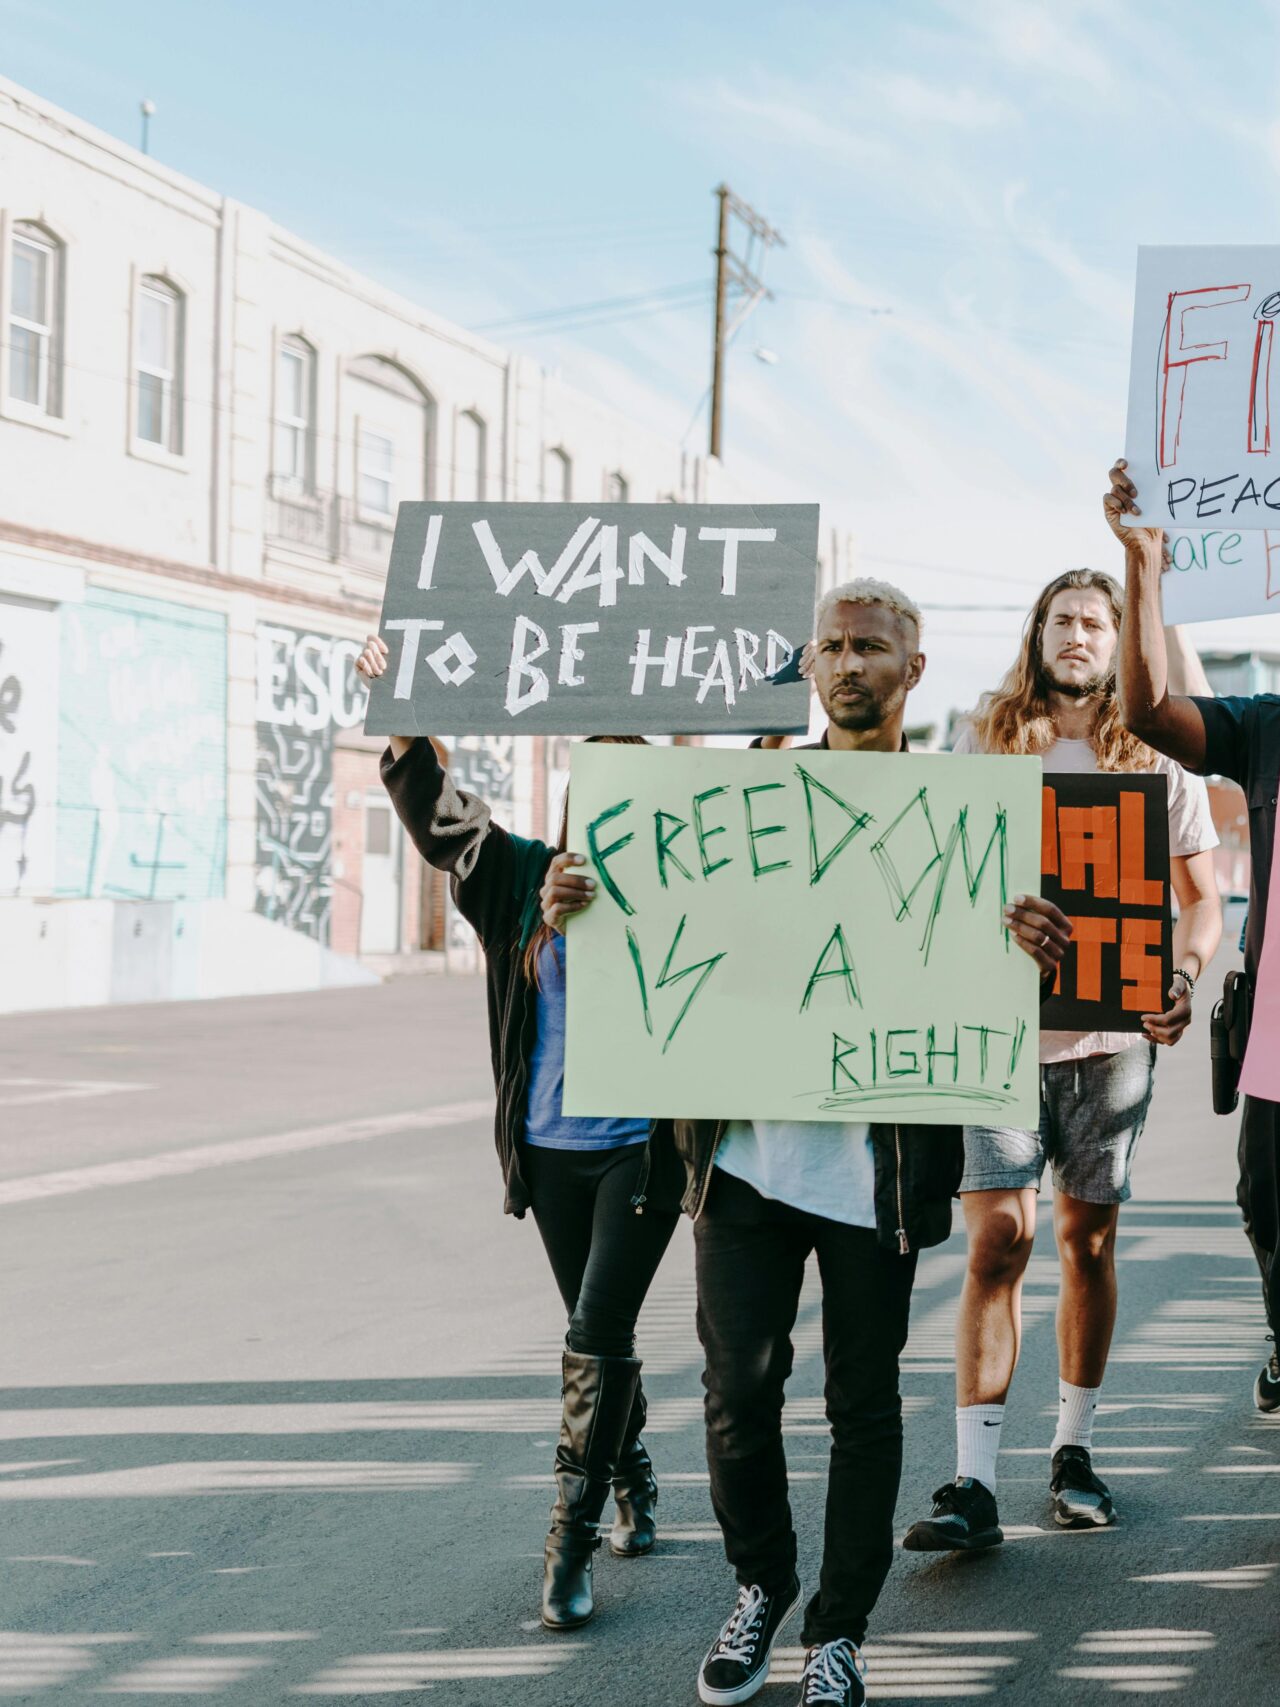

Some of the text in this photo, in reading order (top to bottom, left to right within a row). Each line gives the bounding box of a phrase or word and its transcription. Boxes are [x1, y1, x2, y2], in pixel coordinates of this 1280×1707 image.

[417, 514, 777, 607] I WANT
[1172, 530, 1242, 571] are
[385, 615, 794, 716] TO BE HEARD
[585, 763, 1010, 966] FREEDOM
[625, 914, 864, 1054] IS A
[832, 1017, 1027, 1094] RIGHT!
